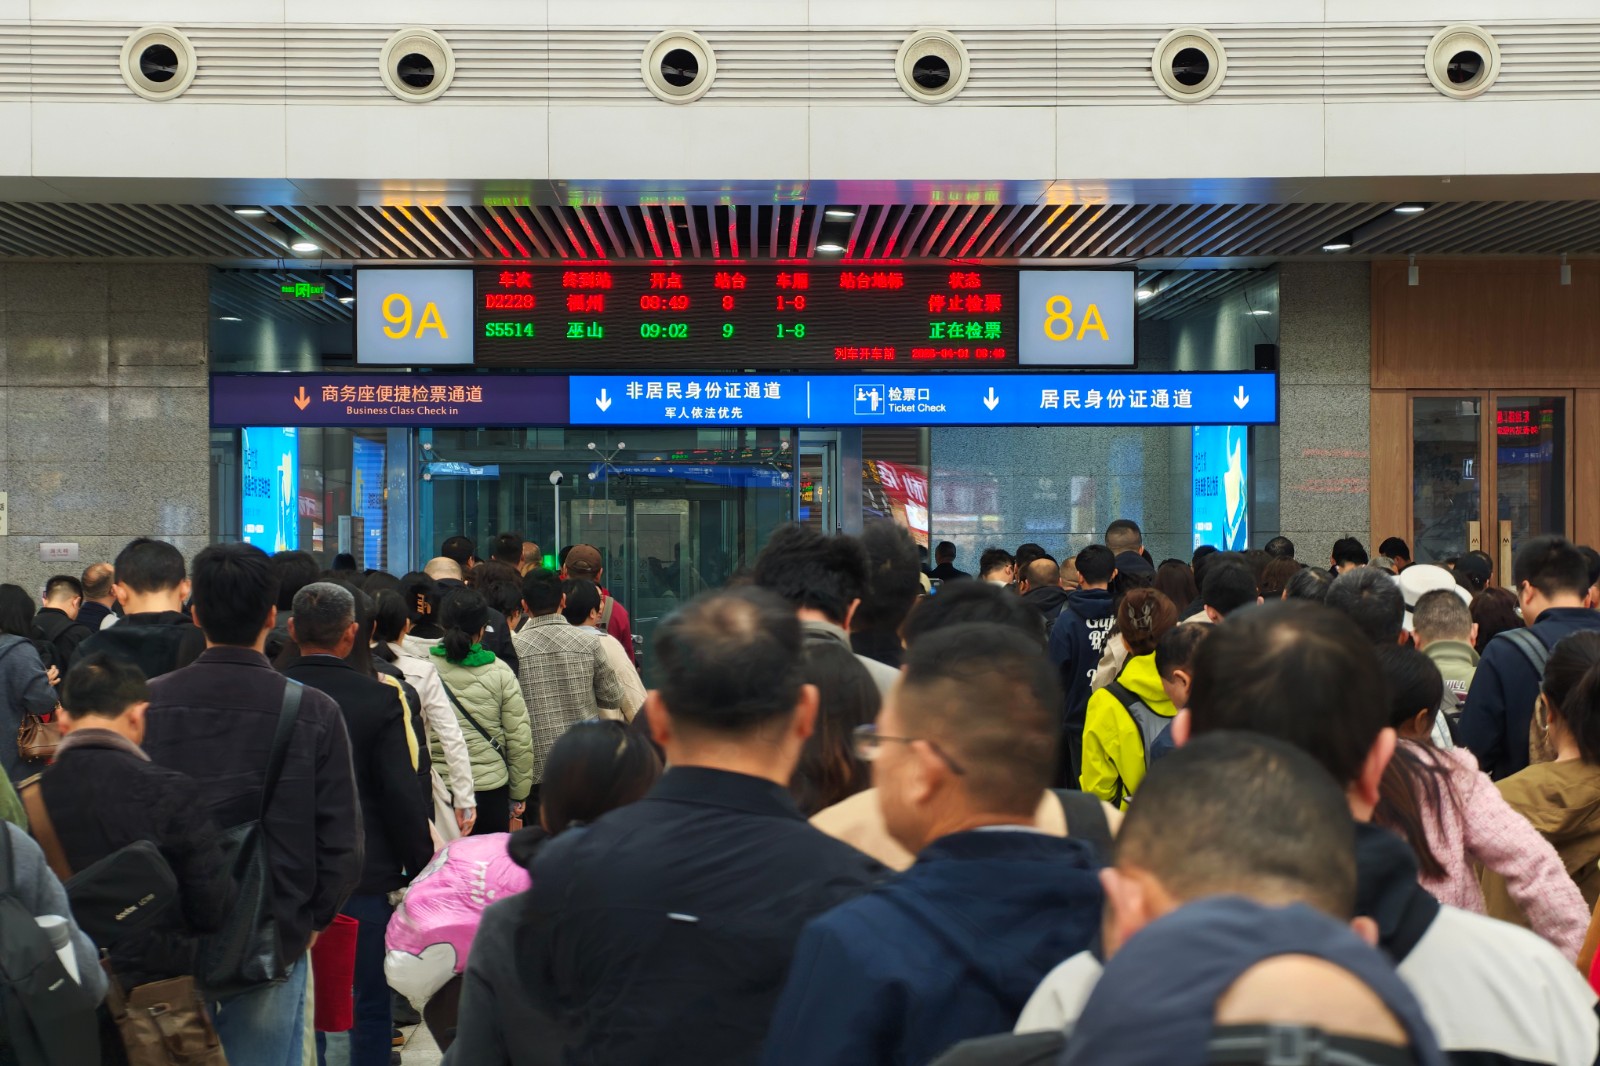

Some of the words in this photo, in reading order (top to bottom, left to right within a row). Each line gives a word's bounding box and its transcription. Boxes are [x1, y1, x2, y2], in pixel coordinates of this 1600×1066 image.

[499, 272, 533, 288] 车次
[562, 272, 613, 289] 终到站
[650, 272, 683, 289] 开点
[714, 272, 747, 289] 站台
[776, 272, 809, 289] 车厢
[839, 272, 904, 289] 站台地标
[949, 272, 982, 289] 状态
[485, 294, 535, 309] D2228
[640, 295, 689, 310] 08:49
[721, 295, 735, 311] 8
[776, 295, 806, 311] 1-8
[928, 294, 1002, 312] 停止检票
[382, 293, 449, 339] 9A
[1044, 295, 1109, 341] 8A
[485, 322, 534, 337] S5514
[566, 321, 604, 339] 巫山
[640, 323, 688, 338] 09:02
[722, 323, 734, 338] 9
[776, 323, 805, 338] 1-8
[928, 321, 1002, 339] 正在检票
[834, 346, 896, 360] 列车开车前
[321, 385, 483, 403] 商务座便捷检票通道
[626, 381, 782, 400] 非居民身份证通道
[888, 386, 930, 401] 检票口
[1039, 389, 1194, 409] 居民身份证通道
[346, 406, 388, 415] Business
[390, 406, 415, 415] Class
[417, 406, 447, 415] Check
[449, 406, 459, 415] in
[664, 406, 744, 419] 军人依法优先
[888, 403, 915, 413] Ticket
[917, 403, 947, 413] Check
